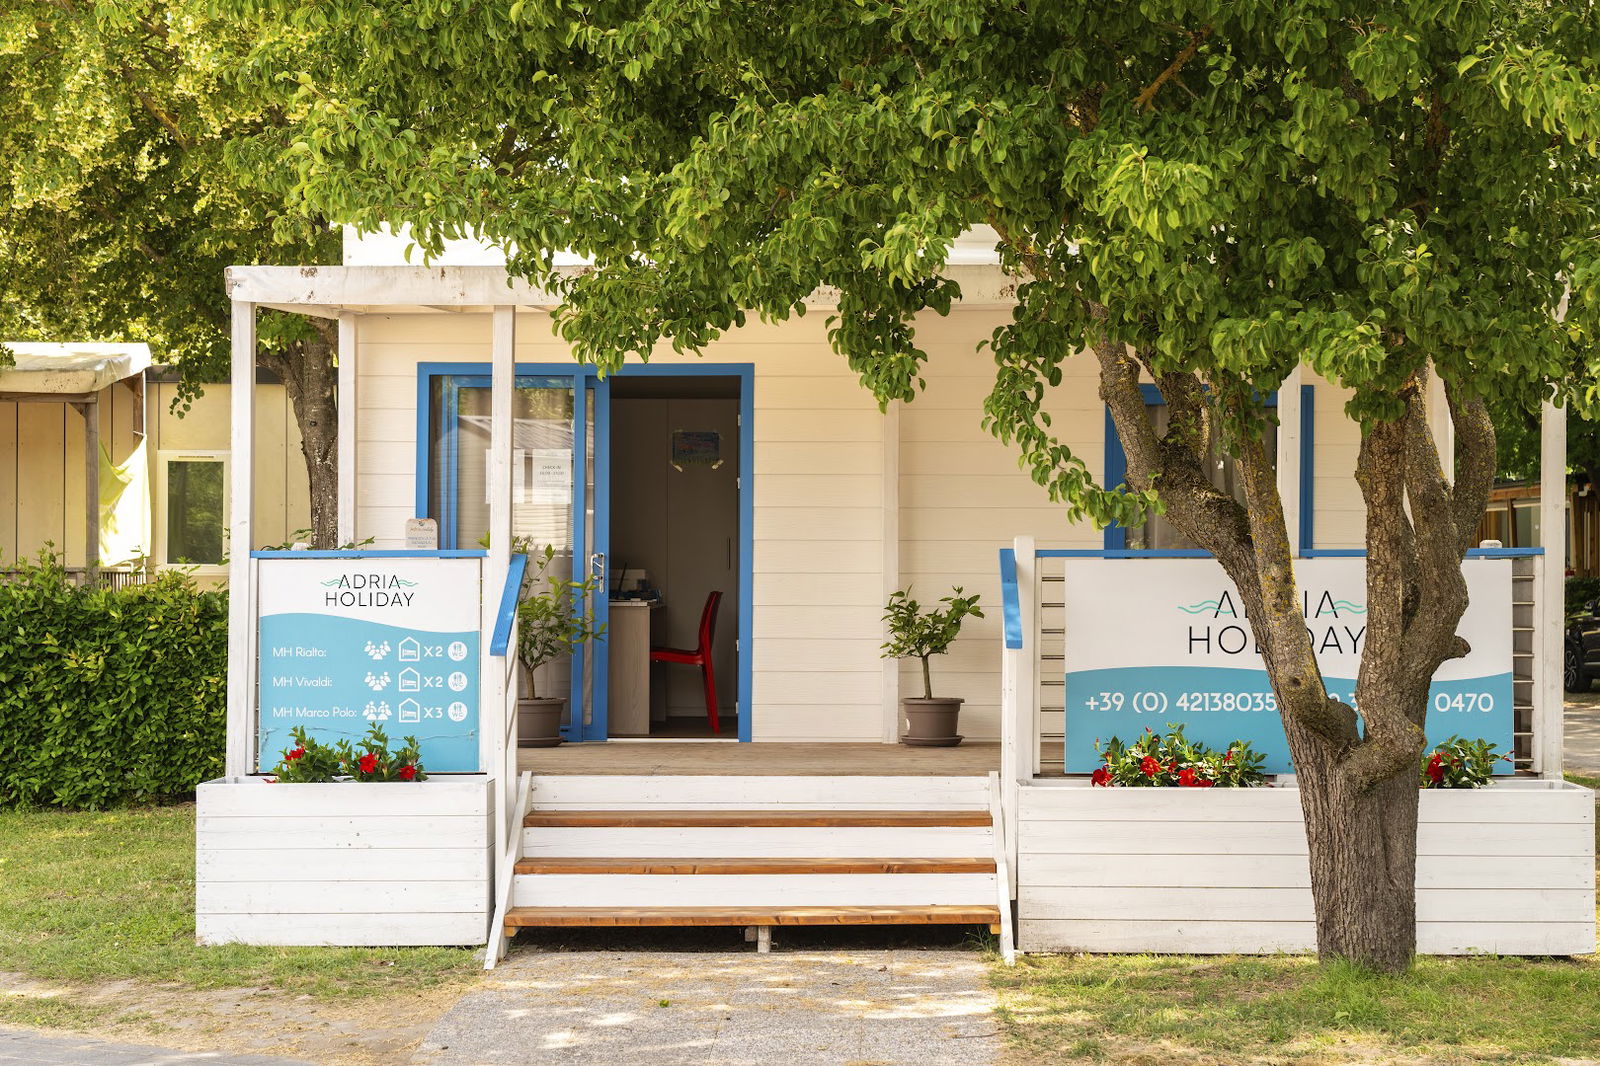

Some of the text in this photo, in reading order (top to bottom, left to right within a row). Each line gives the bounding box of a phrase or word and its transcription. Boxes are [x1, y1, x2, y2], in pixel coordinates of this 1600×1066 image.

[338, 574, 401, 589] ADRIA
[325, 592, 415, 607] HOLIDAY
[1213, 590, 1339, 619] AIA
[272, 647, 292, 657] MH
[295, 646, 327, 657] Rialto:
[272, 677, 292, 687] MH
[295, 676, 333, 687] Vivaldi:
[1085, 692, 1125, 711] +39
[1132, 692, 1168, 713] (0)
[1434, 692, 1494, 713] 0470
[272, 707, 292, 718] MH
[295, 707, 330, 718] Marco
[332, 706, 358, 718] Polo:
